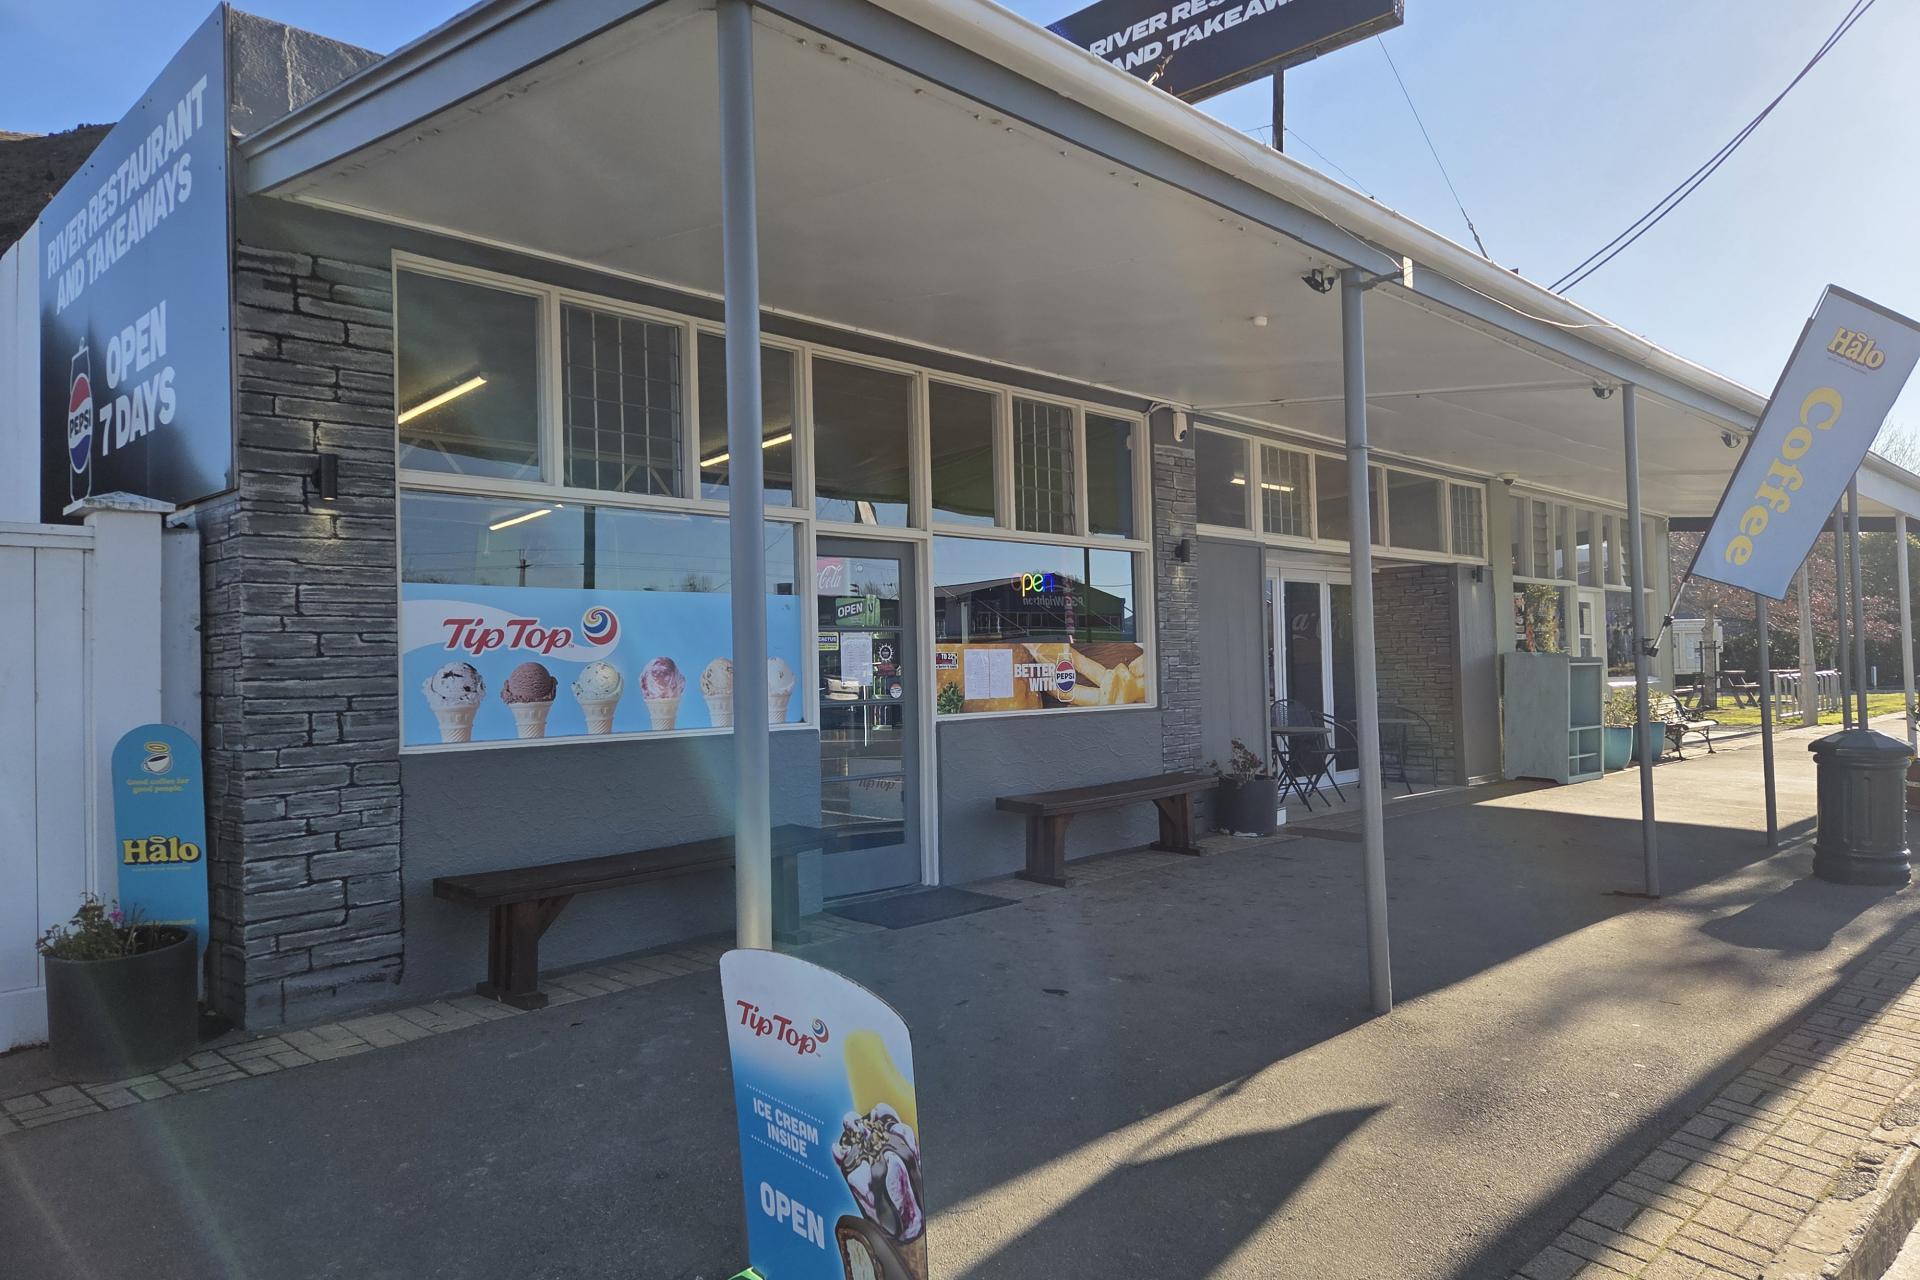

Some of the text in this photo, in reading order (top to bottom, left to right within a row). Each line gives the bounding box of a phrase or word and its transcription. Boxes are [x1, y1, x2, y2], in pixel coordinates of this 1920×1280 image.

[1089, 12, 1168, 56] RIVER
[48, 74, 208, 280] RIVER RESTAURANT
[56, 153, 192, 315] AND TAKEAWAYS
[106, 300, 167, 389] OPEN
[70, 408, 92, 440] PEPSI
[99, 366, 176, 457] 7 DAYS
[1725, 387, 1843, 566] Coffee
[838, 602, 863, 618] OPEN
[443, 618, 505, 655] Tip
[507, 620, 572, 654] Top
[1014, 664, 1055, 678] BETTER
[1029, 678, 1057, 692] WITH
[1057, 672, 1075, 680] PEPSI
[736, 1000, 817, 1055] Tip Top
[753, 1097, 819, 1145] ICE CREAM
[767, 1122, 808, 1158] INSIDE
[760, 1181, 825, 1250] OPEN
